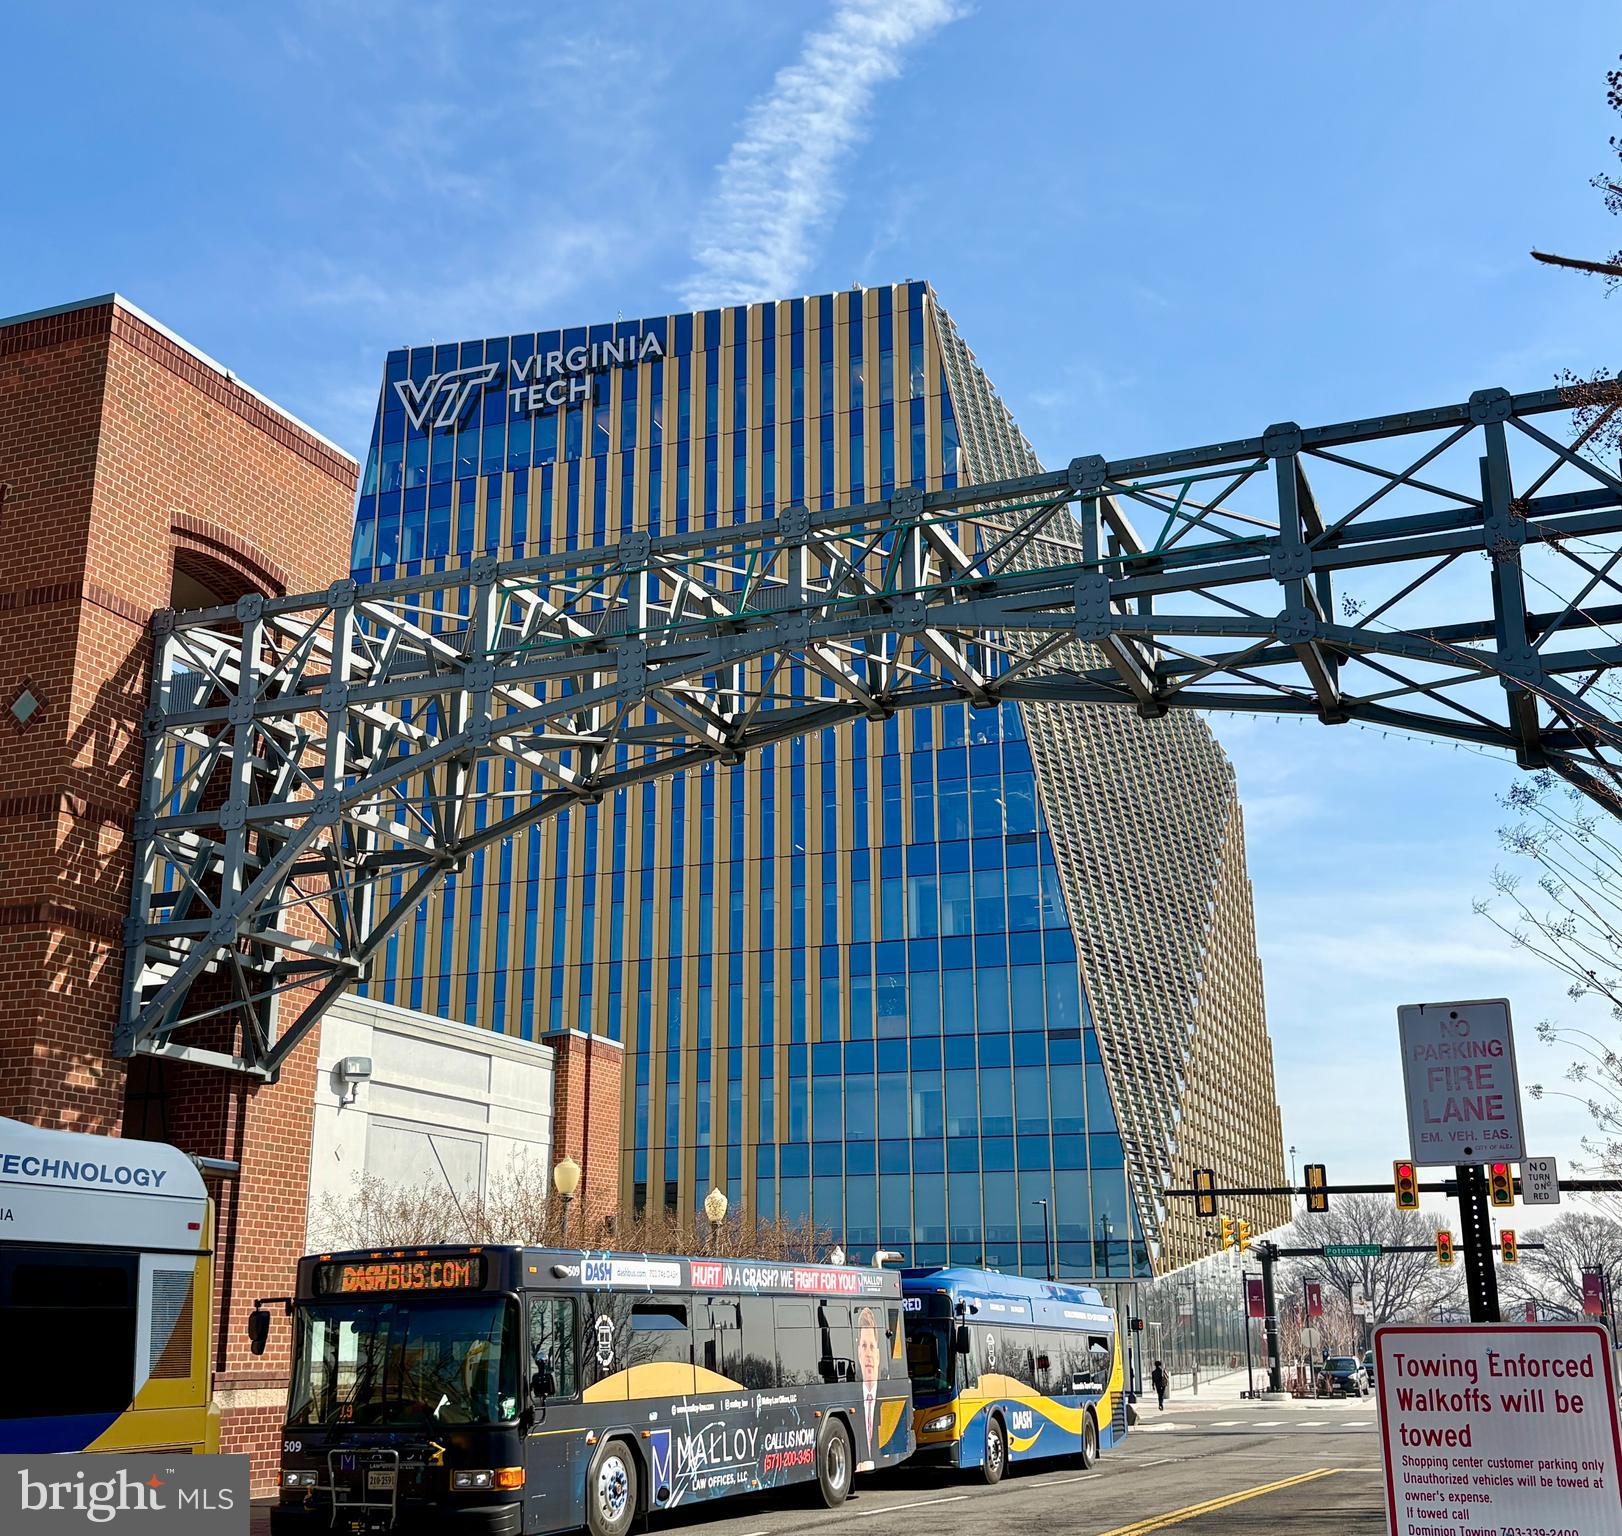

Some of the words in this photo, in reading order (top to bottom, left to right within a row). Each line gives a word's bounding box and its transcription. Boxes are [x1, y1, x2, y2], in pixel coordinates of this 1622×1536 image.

[511, 331, 663, 381] VIRGINIA
[509, 374, 592, 413] TECH
[1440, 1019, 1471, 1038] NO
[1413, 1039, 1504, 1061] PARKING
[1426, 1063, 1495, 1092] FIRE
[1422, 1094, 1505, 1124] LANE
[1420, 1131, 1443, 1143] EM.
[1448, 1130, 1478, 1141] VEH.
[1483, 1128, 1513, 1140] EAS.
[0, 1153, 167, 1187] ECHNOLOGY
[1528, 1173, 1550, 1181] TURN
[1529, 1162, 1547, 1171] NO
[1533, 1192, 1550, 1200] RED
[342, 1261, 470, 1292] DASHBUS.COM
[585, 1262, 612, 1281] DASH
[691, 1263, 722, 1287] HURT
[722, 1265, 732, 1286] IN
[733, 1267, 741, 1286] A
[742, 1268, 779, 1288] CRASH?
[779, 1269, 794, 1288] WE
[795, 1270, 820, 1290] FIGHT
[820, 1271, 837, 1290] FOR
[838, 1271, 857, 1291] YOU!
[1393, 1352, 1479, 1384] Towing
[1488, 1352, 1594, 1378] Enforced
[1396, 1388, 1492, 1412] Walkoffs
[1500, 1388, 1544, 1413] will
[1554, 1389, 1584, 1413] be
[1012, 1410, 1033, 1430] DASH
[764, 1431, 786, 1451] CALL
[785, 1430, 794, 1448] US
[794, 1428, 815, 1446] NOW!
[1399, 1423, 1472, 1447] towed
[284, 1440, 302, 1453] 509
[677, 1427, 758, 1469] MALLOY
[1402, 1454, 1448, 1470] Shopping
[1452, 1456, 1483, 1468] center
[1487, 1457, 1534, 1469] customer
[1538, 1458, 1578, 1473] parking
[1582, 1460, 1605, 1473] only
[692, 1478, 706, 1491] LAW
[707, 1473, 736, 1488] OFFICES,
[737, 1470, 748, 1482] LLC
[1403, 1472, 1469, 1485] Unauthorized
[1472, 1473, 1514, 1486] vehicles
[1517, 1475, 1537, 1487] will
[1540, 1475, 1553, 1487] be
[1556, 1476, 1589, 1488] towed
[1593, 1477, 1604, 1488] at
[1405, 1490, 1445, 1502] owner's
[1448, 1492, 1493, 1505] expense.
[1406, 1506, 1415, 1518] If
[1416, 1507, 1448, 1519] towed
[1451, 1508, 1470, 1520] call
[1408, 1524, 1456, 1536] Dominion
[1459, 1526, 1497, 1536] Towing
